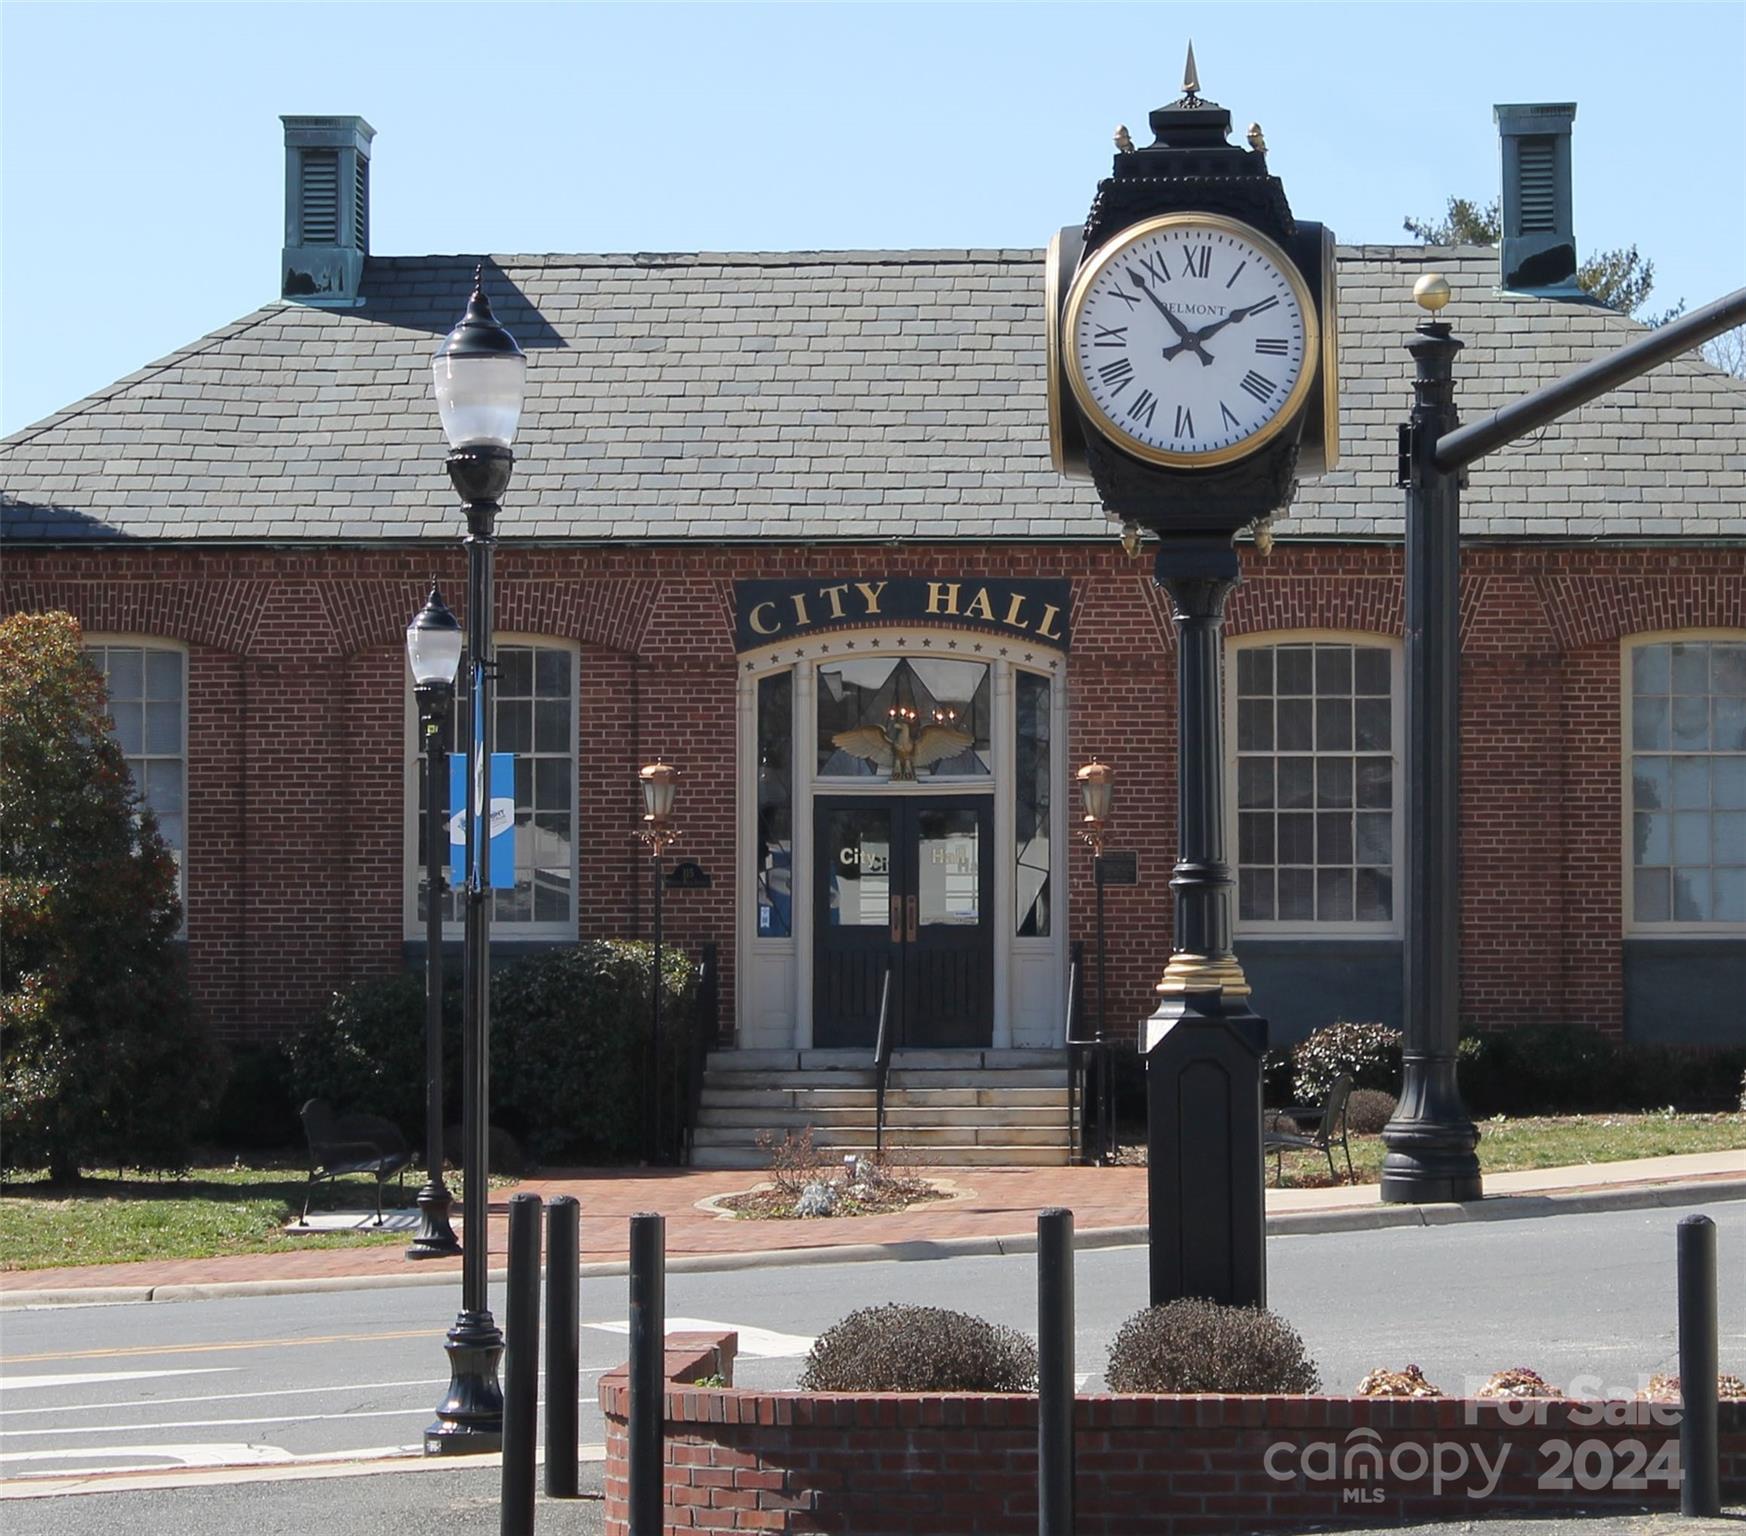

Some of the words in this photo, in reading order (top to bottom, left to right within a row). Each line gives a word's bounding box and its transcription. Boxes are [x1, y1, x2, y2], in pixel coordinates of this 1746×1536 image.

[1139, 250, 1171, 289] XI
[1182, 244, 1212, 278] XII
[1107, 282, 1142, 312] X
[1094, 323, 1128, 348] IX
[1255, 338, 1288, 356] III
[1098, 357, 1135, 398] VIII
[1126, 388, 1158, 429] VII
[1174, 404, 1195, 439] VI
[1219, 400, 1241, 432] V
[749, 580, 889, 635] CITY
[924, 581, 1062, 640] HALL
[839, 847, 876, 866] City
